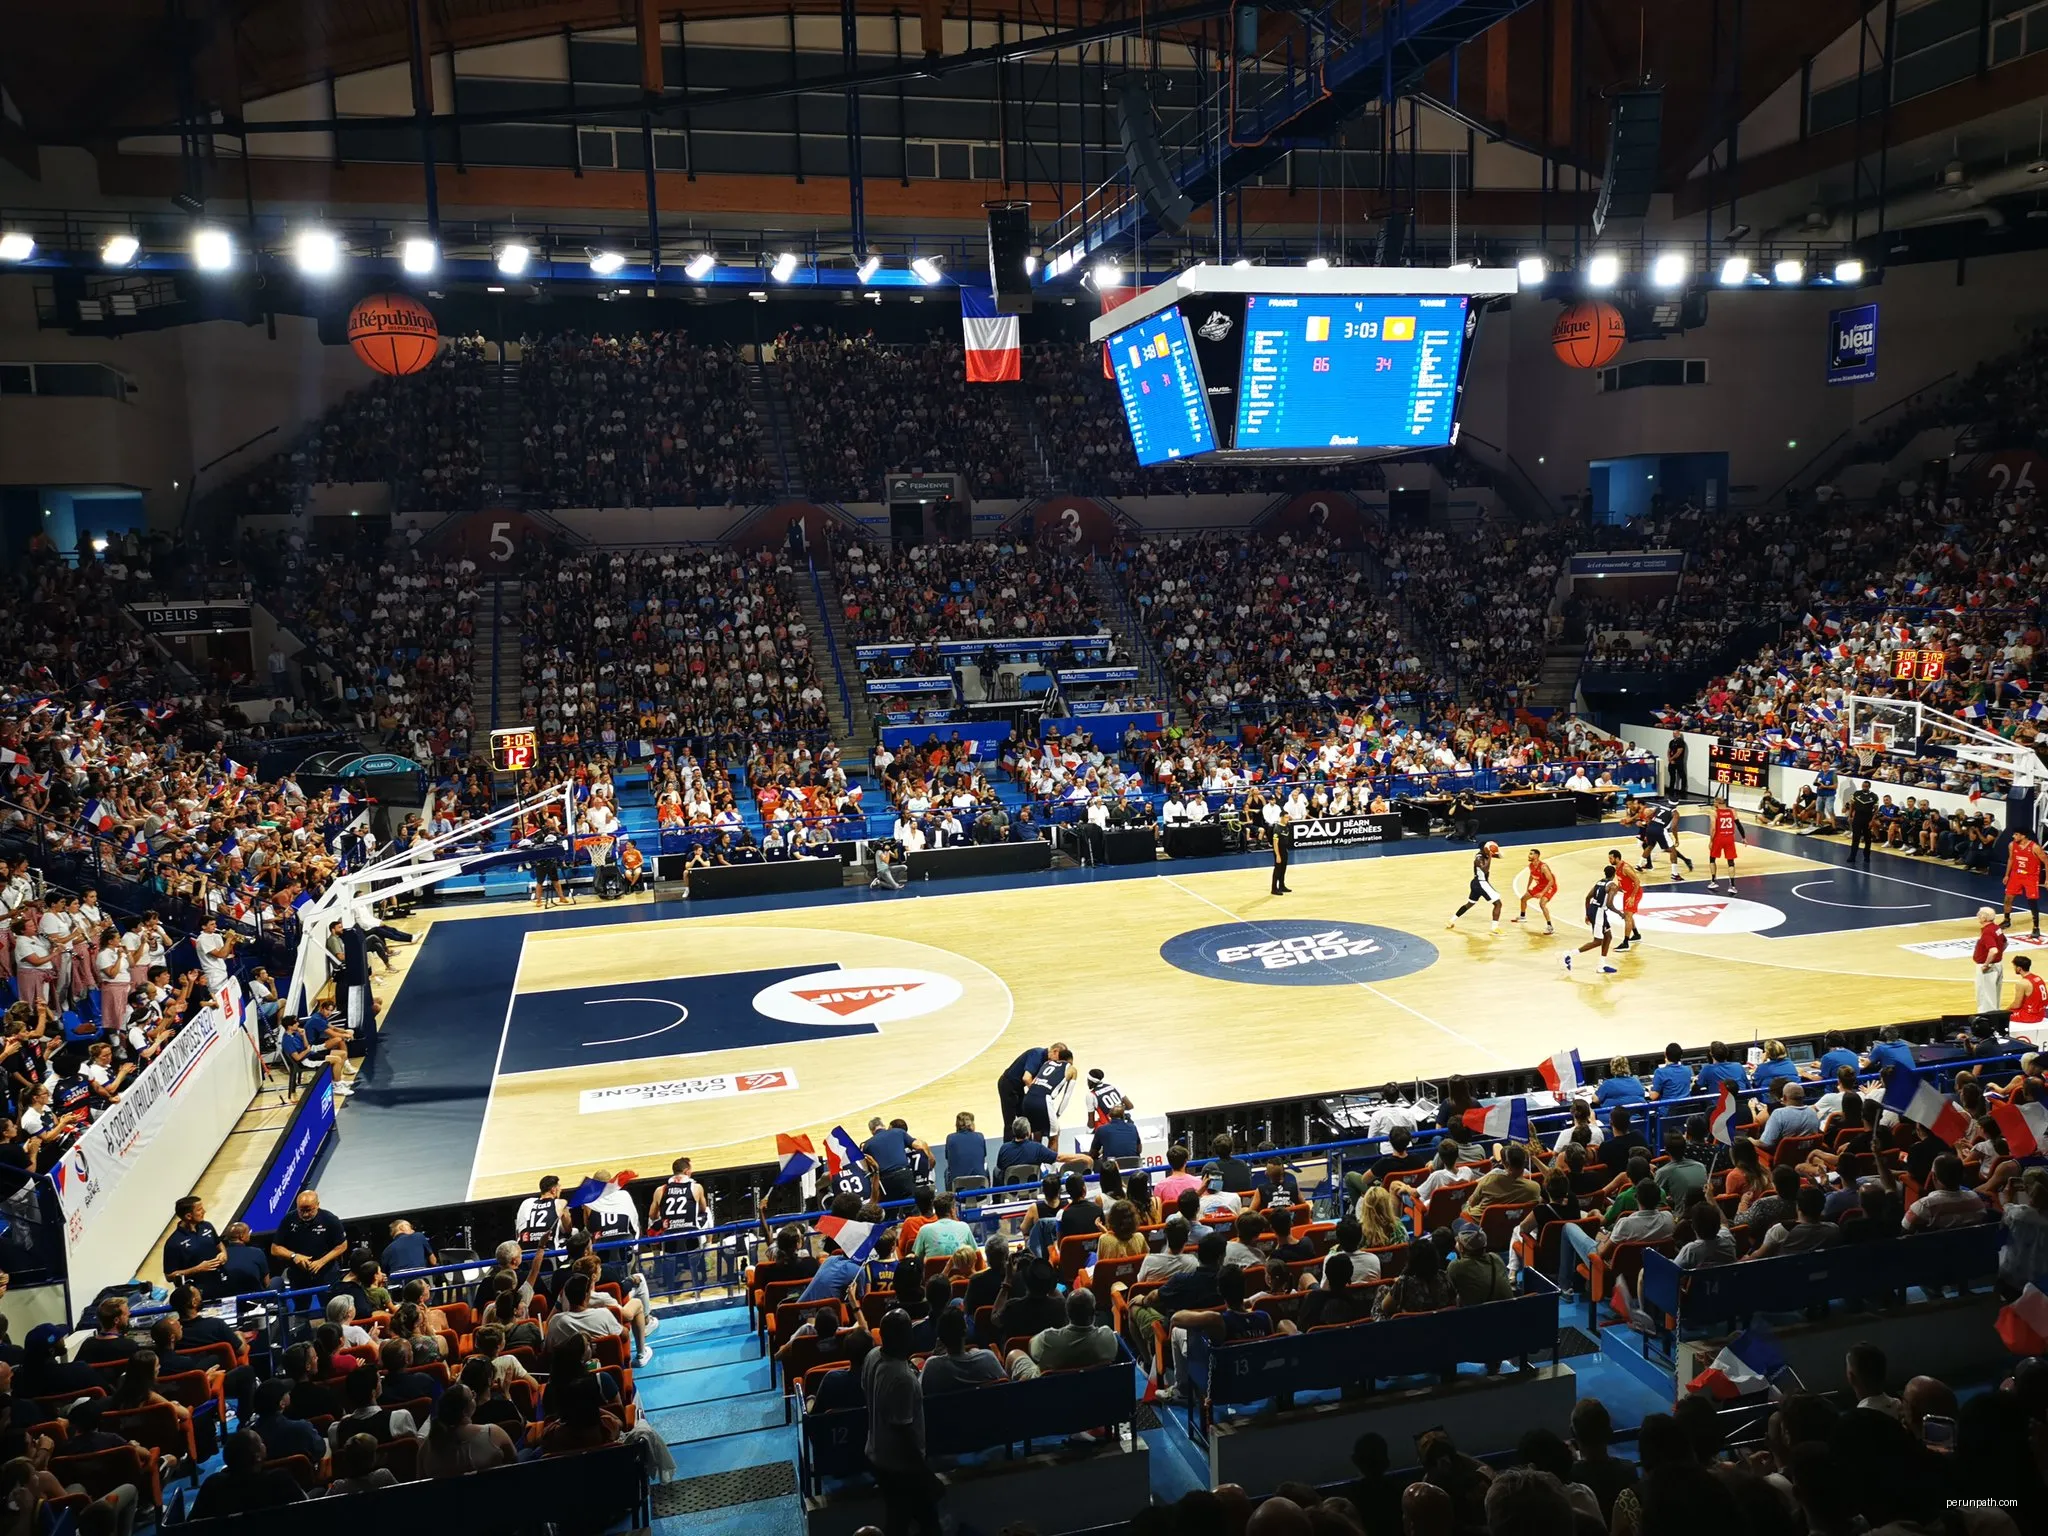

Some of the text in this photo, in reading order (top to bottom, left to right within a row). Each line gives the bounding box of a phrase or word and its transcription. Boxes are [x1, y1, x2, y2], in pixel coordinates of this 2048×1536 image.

[1344, 322, 1378, 339] 3:03
[1840, 329, 1873, 350] bleu
[1313, 357, 1330, 372] 86
[1375, 357, 1392, 372] 34
[1061, 508, 1082, 543] 3
[489, 522, 515, 562] 5
[147, 609, 199, 622] IDELIS
[1898, 661, 1912, 676] 12
[1923, 663, 1938, 678] 12
[502, 733, 533, 748] 3:02
[508, 746, 528, 766] 12
[1717, 769, 1731, 784] 86
[1734, 771, 1741, 782] 4
[1744, 773, 1758, 787] 34
[1293, 820, 1341, 840] PAU
[1343, 819, 1370, 829] BÉARN
[1343, 825, 1383, 836] PYRÉNÉES
[1719, 817, 1733, 829] 23
[1293, 835, 1383, 848] Communauté d'Agglomération
[808, 986, 908, 1005] MAIF
[1042, 1066, 1056, 1077] 0
[641, 1084, 726, 1100] CAISSE
[1101, 1091, 1122, 1109] 00
[839, 1176, 864, 1194] 93
[665, 1196, 688, 1216] 22
[530, 1210, 548, 1228] 12
[600, 1212, 619, 1227] 10
[831, 1427, 849, 1446] 12
